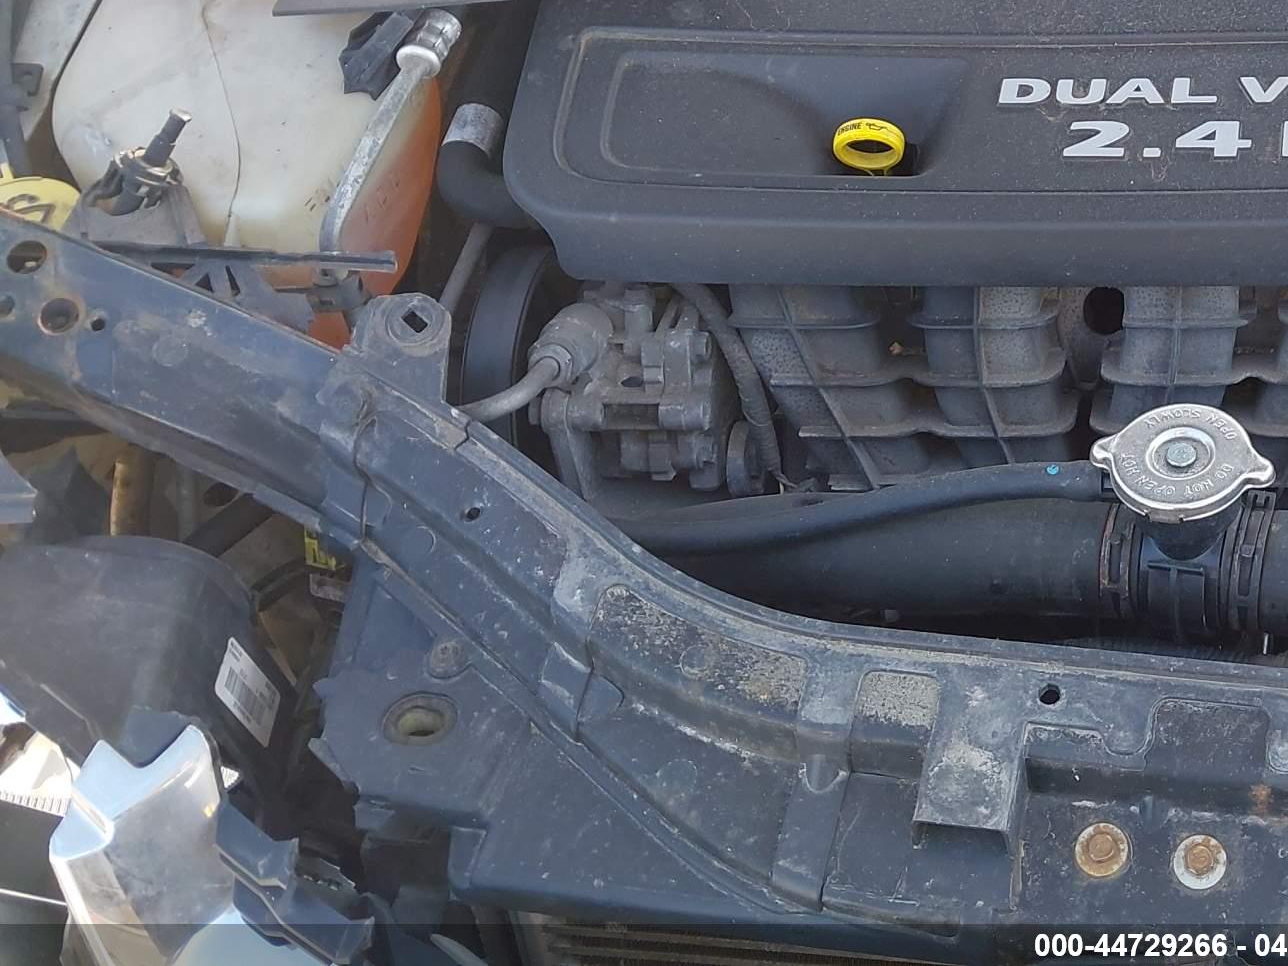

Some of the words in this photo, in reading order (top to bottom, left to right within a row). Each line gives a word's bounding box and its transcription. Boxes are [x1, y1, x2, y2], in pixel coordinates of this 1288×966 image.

[998, 77, 1218, 104] DUAL
[837, 121, 862, 136] ENGINE
[1062, 120, 1252, 157] 2.4
[1144, 408, 1202, 429] SLOWLY
[1206, 412, 1237, 441] OPEN
[1121, 452, 1139, 476] HOT
[1214, 463, 1235, 480] DO
[1135, 474, 1176, 496] OPEN
[1183, 479, 1215, 496] NOT
